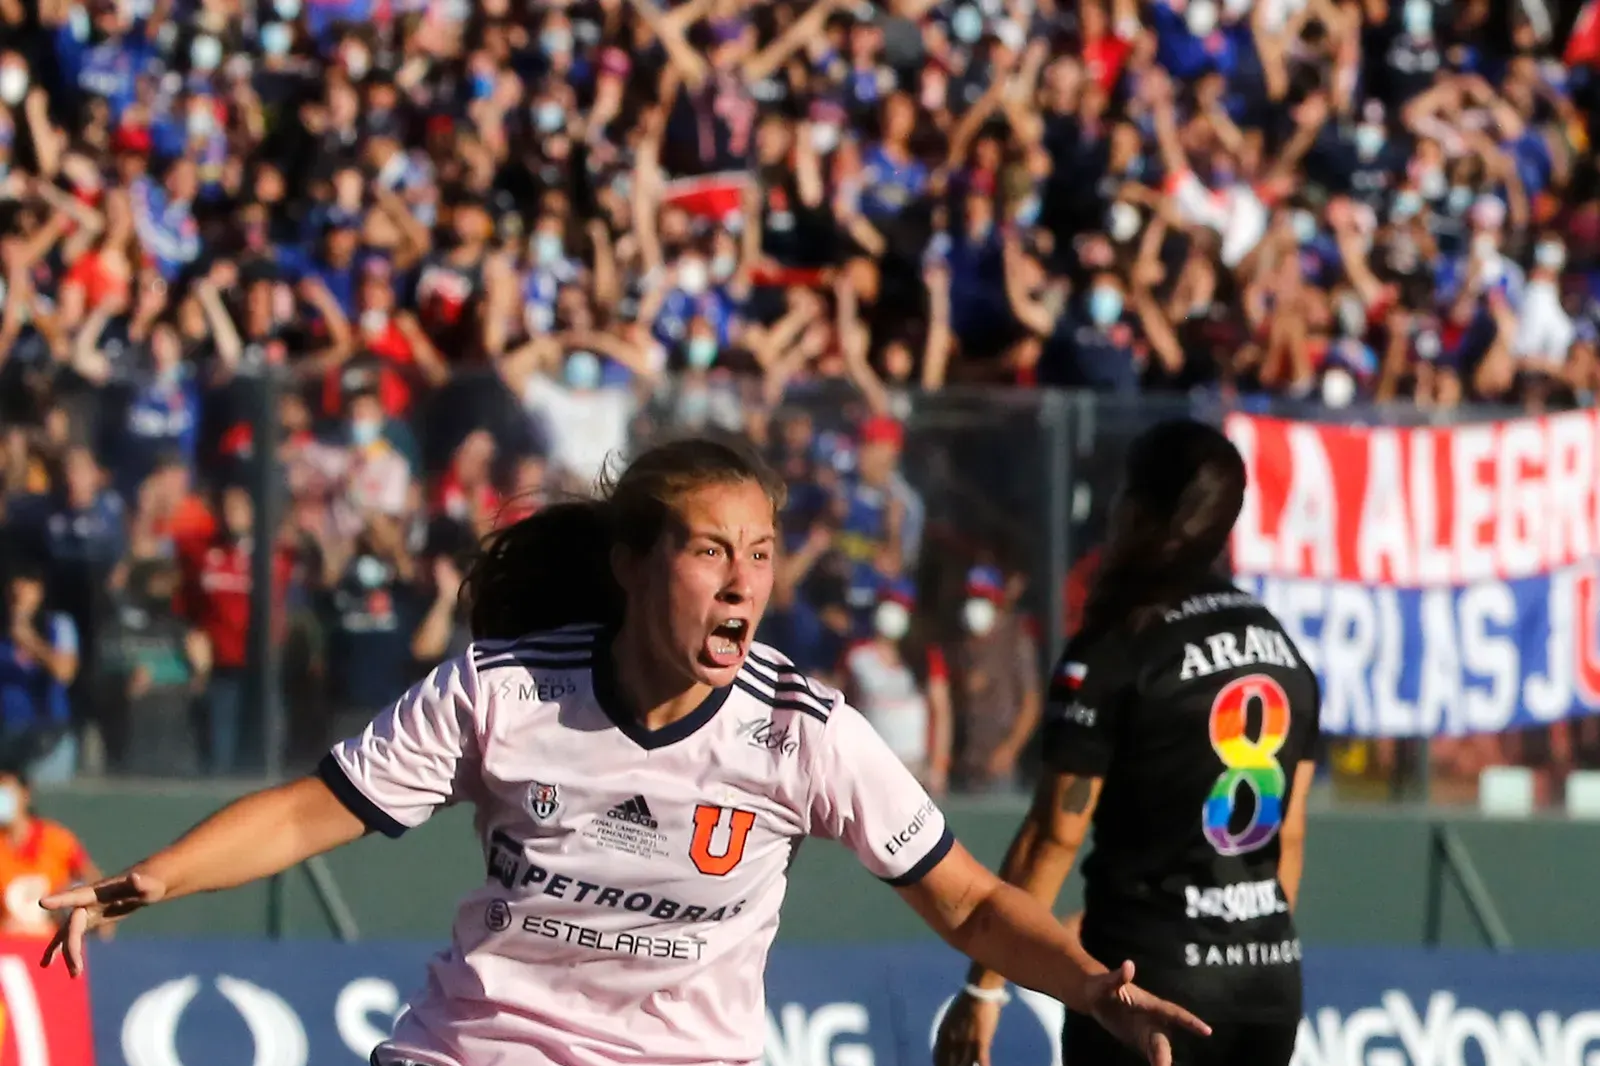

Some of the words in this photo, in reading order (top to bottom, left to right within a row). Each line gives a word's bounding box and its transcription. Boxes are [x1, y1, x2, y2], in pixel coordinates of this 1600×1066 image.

[1228, 415, 1340, 577] LA
[1236, 573, 1520, 737] ERLAS
[1202, 673, 1291, 856] 8
[607, 809, 658, 830] adidas
[689, 804, 756, 876] U
[520, 864, 746, 922] PETROBRAS
[522, 915, 708, 961] ESTELARBET
